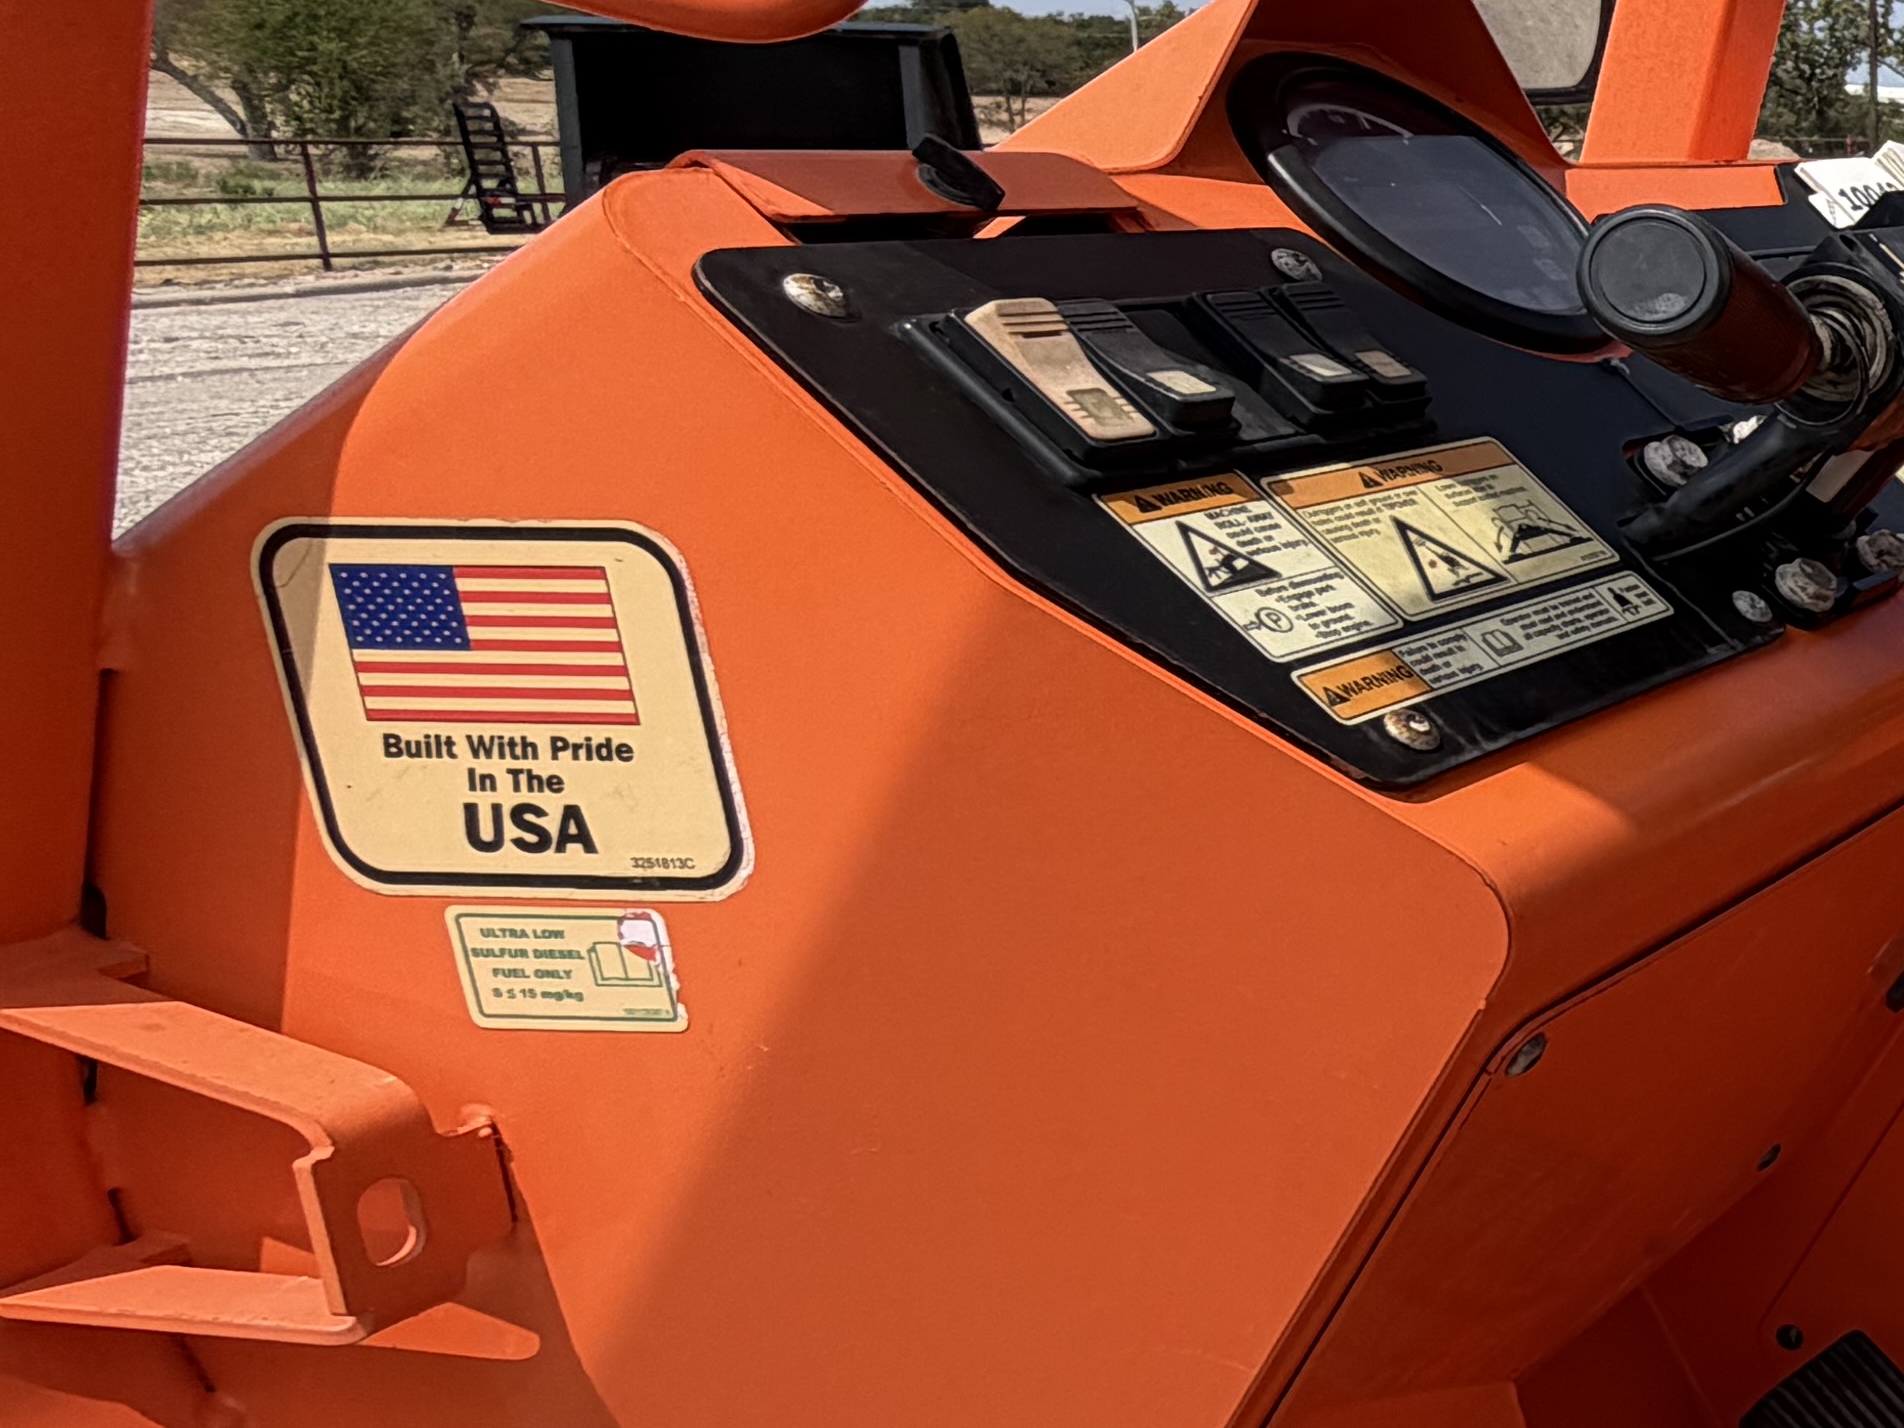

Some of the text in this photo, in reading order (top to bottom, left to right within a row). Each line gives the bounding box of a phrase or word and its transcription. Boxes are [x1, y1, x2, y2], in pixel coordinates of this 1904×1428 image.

[1838, 182, 1898, 212] 100
[1378, 460, 1443, 482] WARNING
[1152, 481, 1234, 507] WARNING
[1338, 665, 1413, 698] WARNING
[383, 734, 634, 763] Built With Pride
[467, 768, 565, 794] In The
[463, 802, 599, 855] USA
[480, 928, 565, 940] ULTRA LOW
[471, 947, 585, 960] SULFUR DIESEL
[492, 968, 573, 980] FUEL ONLY
